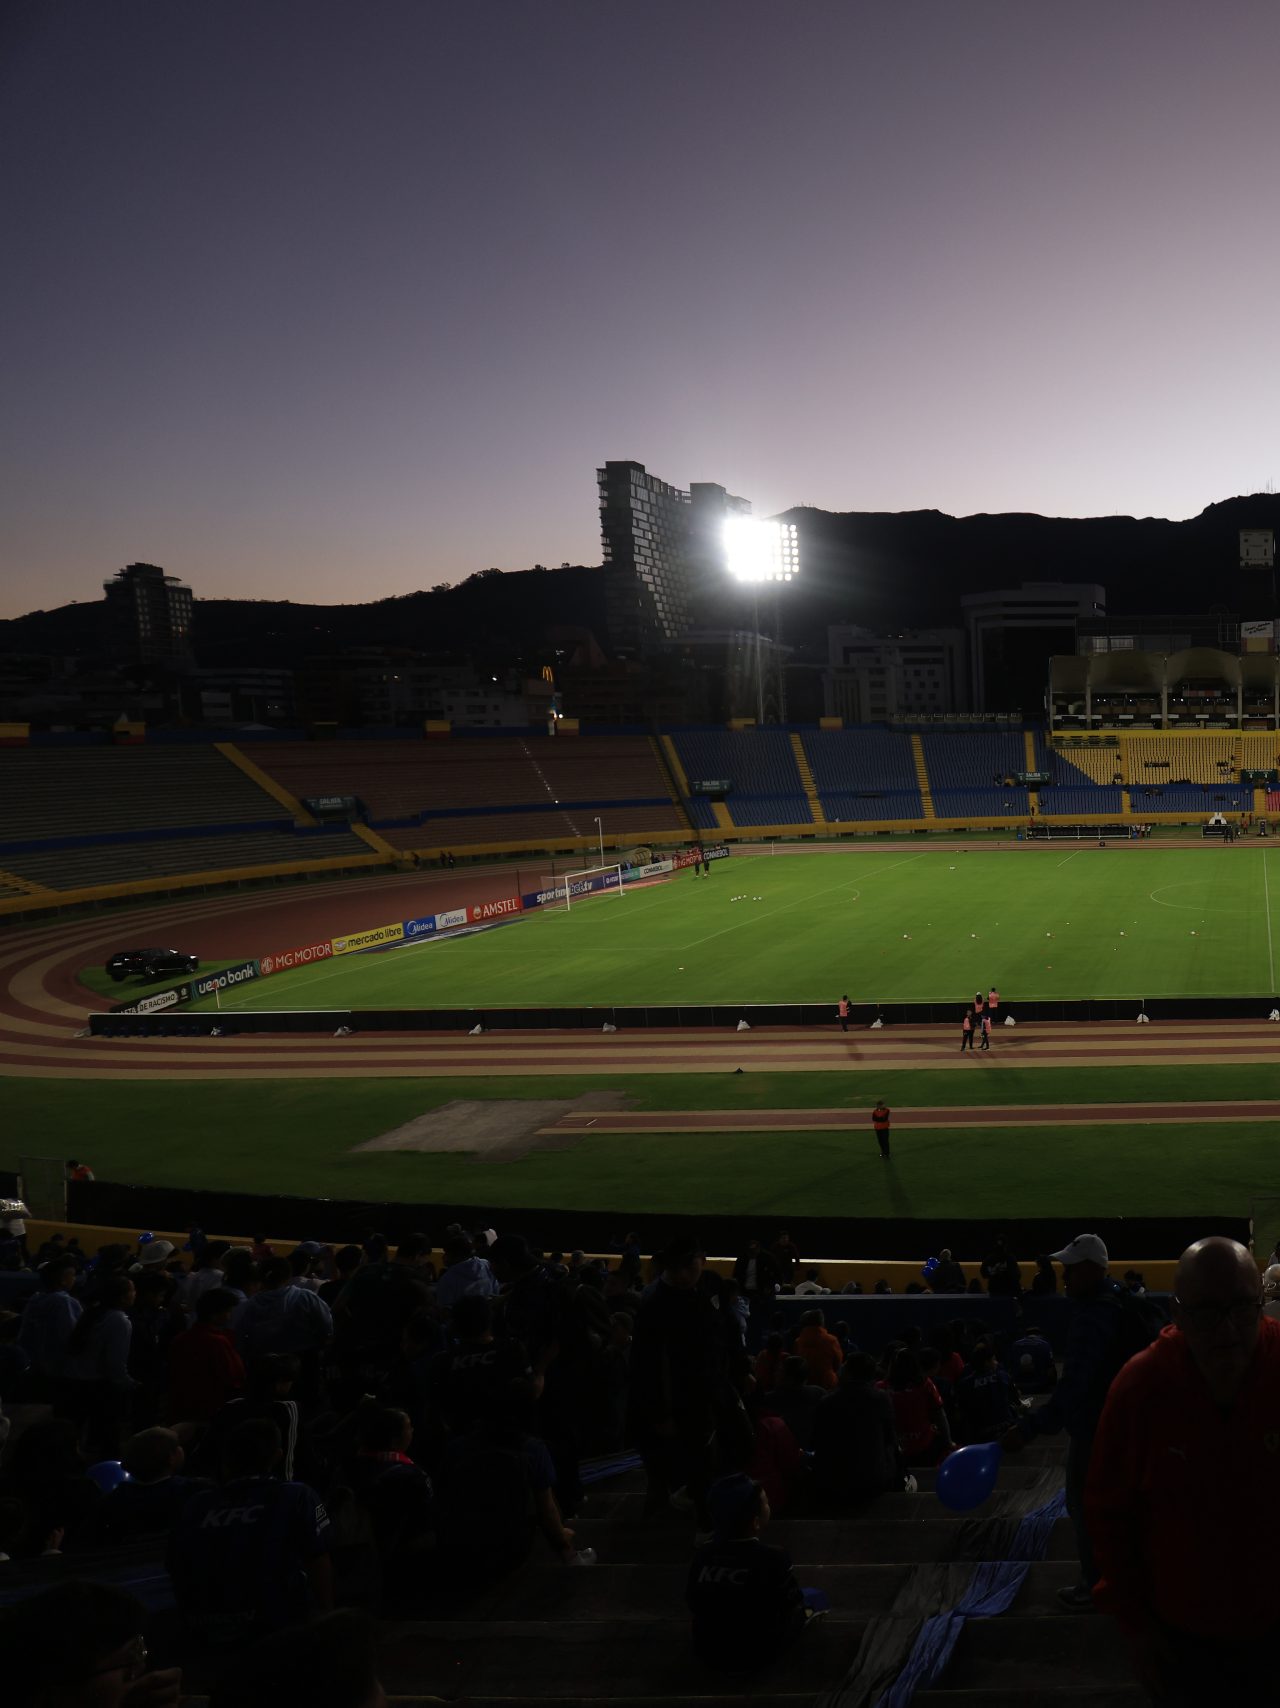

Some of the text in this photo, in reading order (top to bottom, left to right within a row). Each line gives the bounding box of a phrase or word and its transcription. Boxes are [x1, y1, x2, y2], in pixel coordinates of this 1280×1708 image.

[483, 899, 518, 917] AMSTEL
[348, 925, 402, 948] mercado libre
[413, 920, 433, 934] Midea
[276, 954, 293, 969] MG
[294, 943, 332, 963] MOTOR
[228, 965, 254, 985] bank
[140, 1003, 149, 1012] DE
[452, 1350, 497, 1371] KFC
[201, 1504, 265, 1529] KFC
[697, 1566, 751, 1585] KFC
